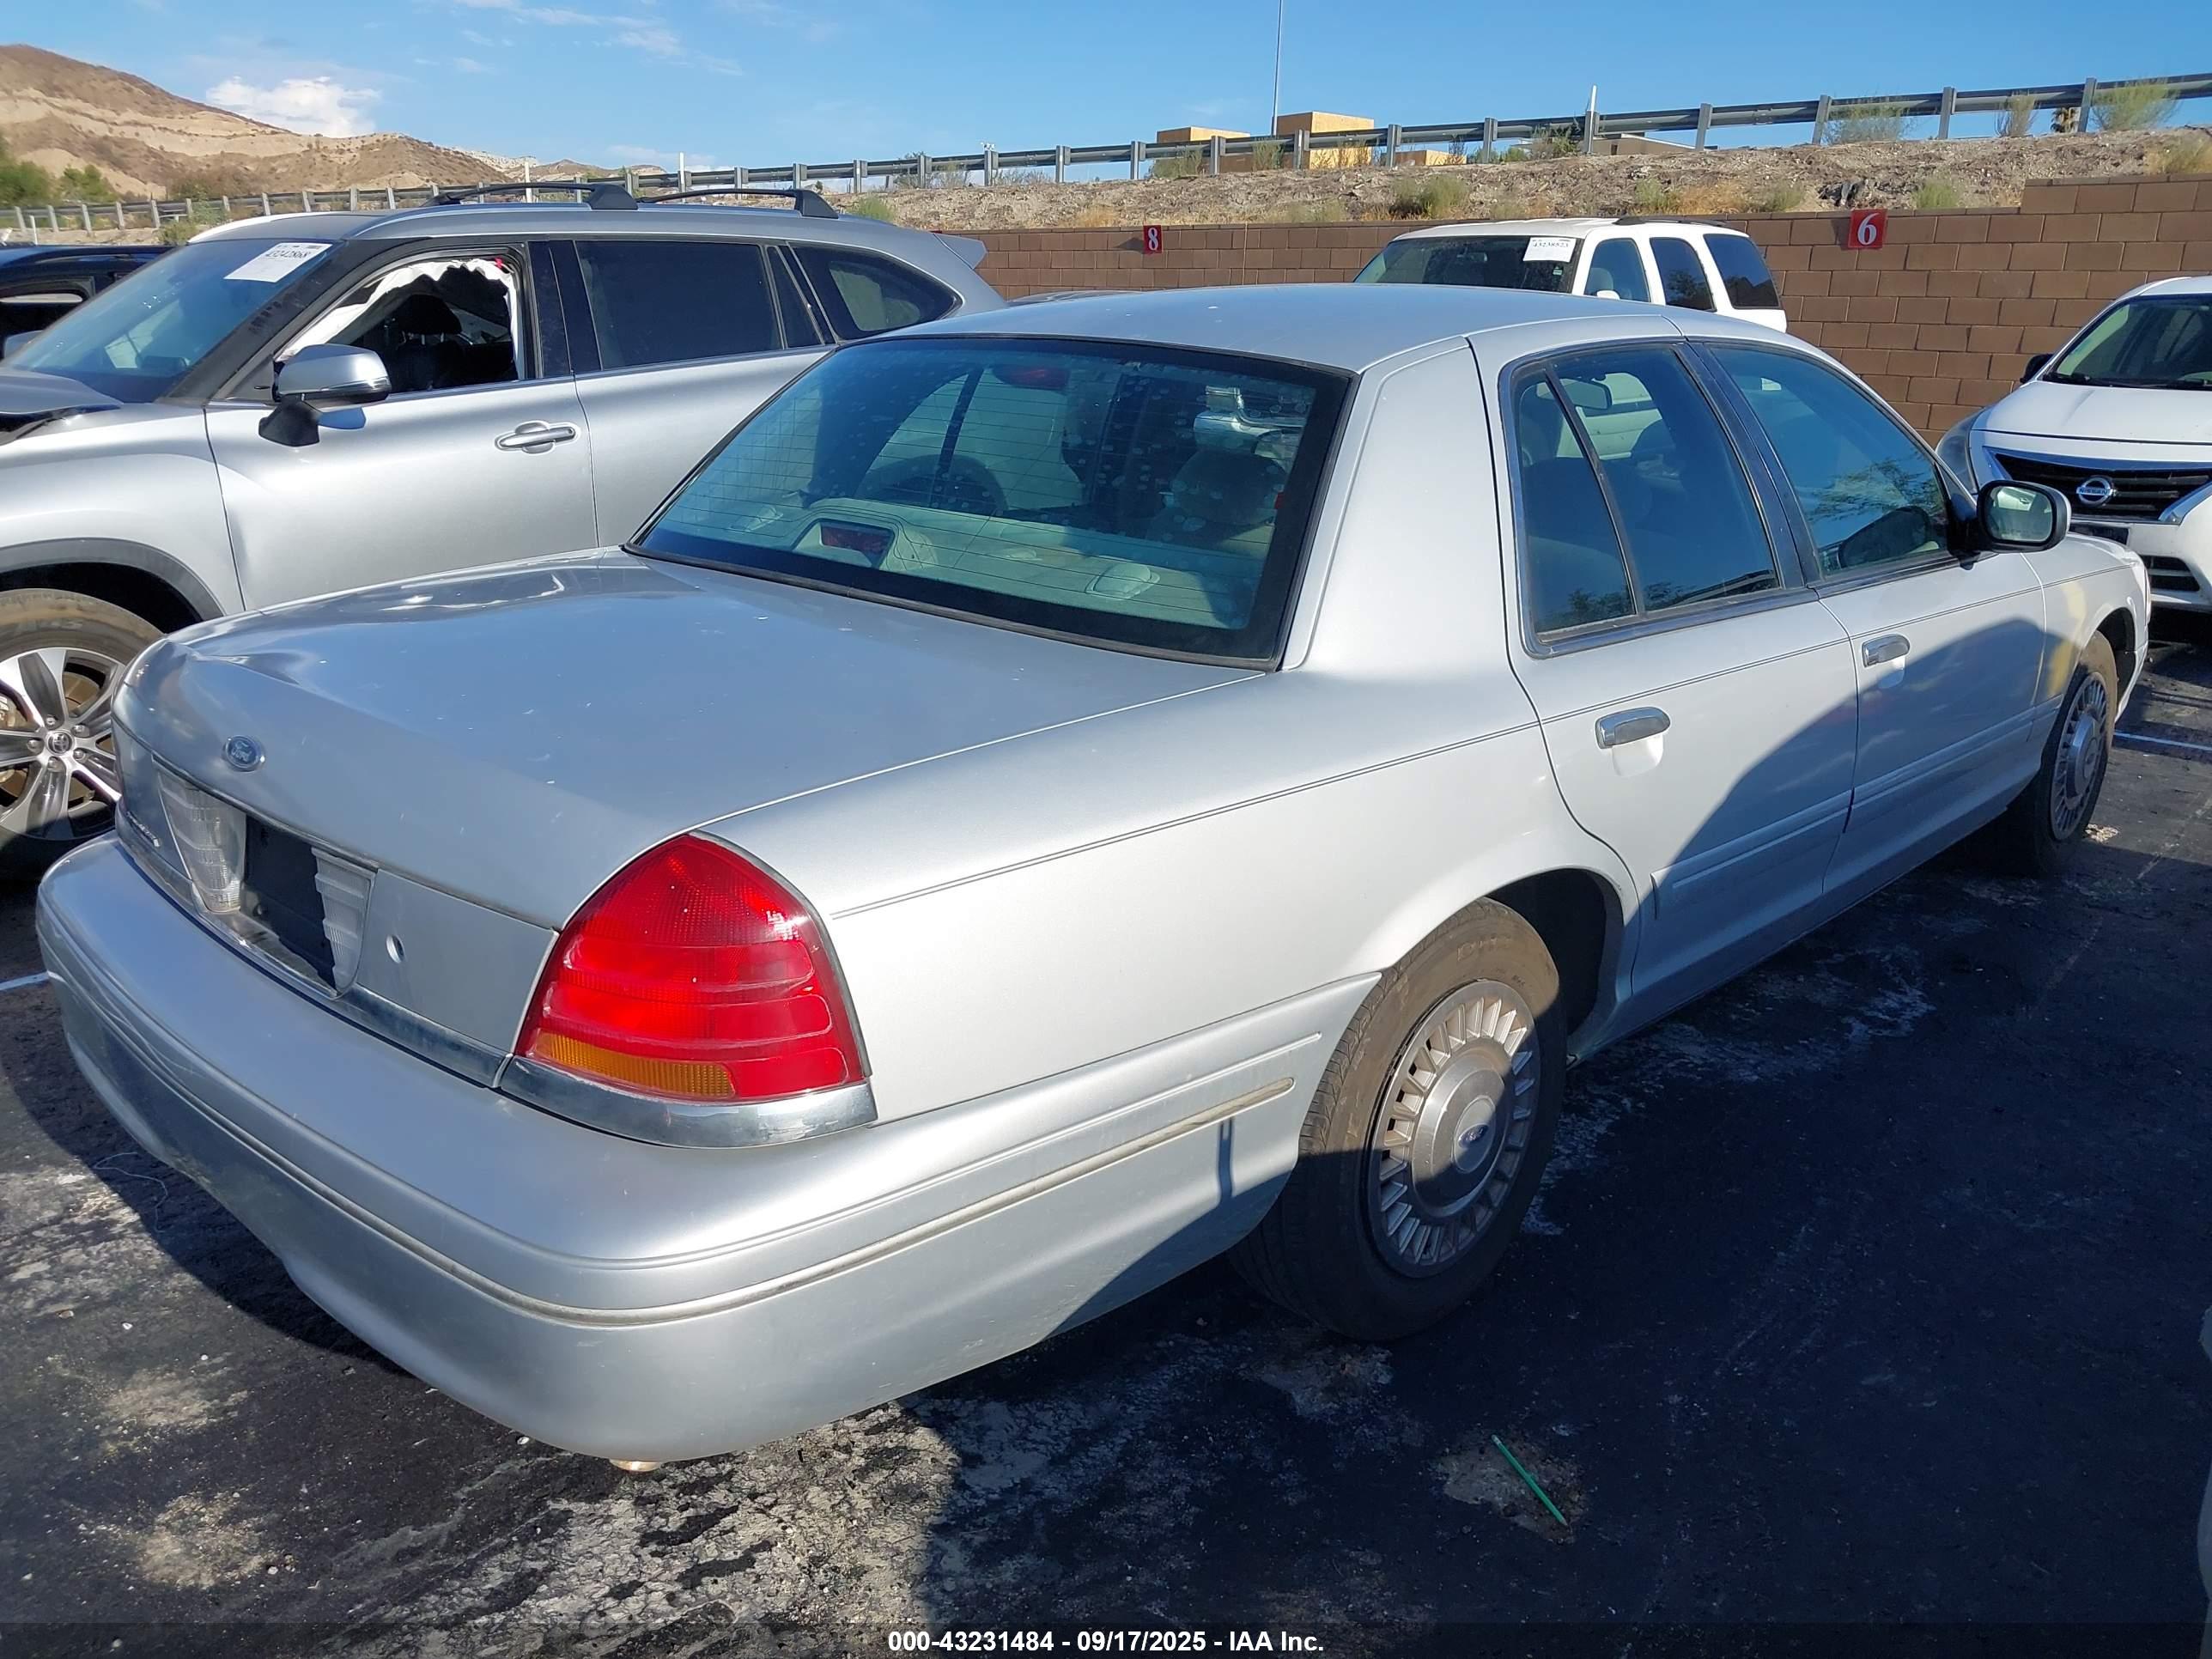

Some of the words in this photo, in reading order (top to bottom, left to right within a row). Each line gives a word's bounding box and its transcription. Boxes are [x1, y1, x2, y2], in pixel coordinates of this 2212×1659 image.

[1147, 227, 1158, 251] 8
[1857, 212, 1879, 246] 6
[2079, 487, 2109, 495] NISSAN
[231, 740, 252, 763] Ford
